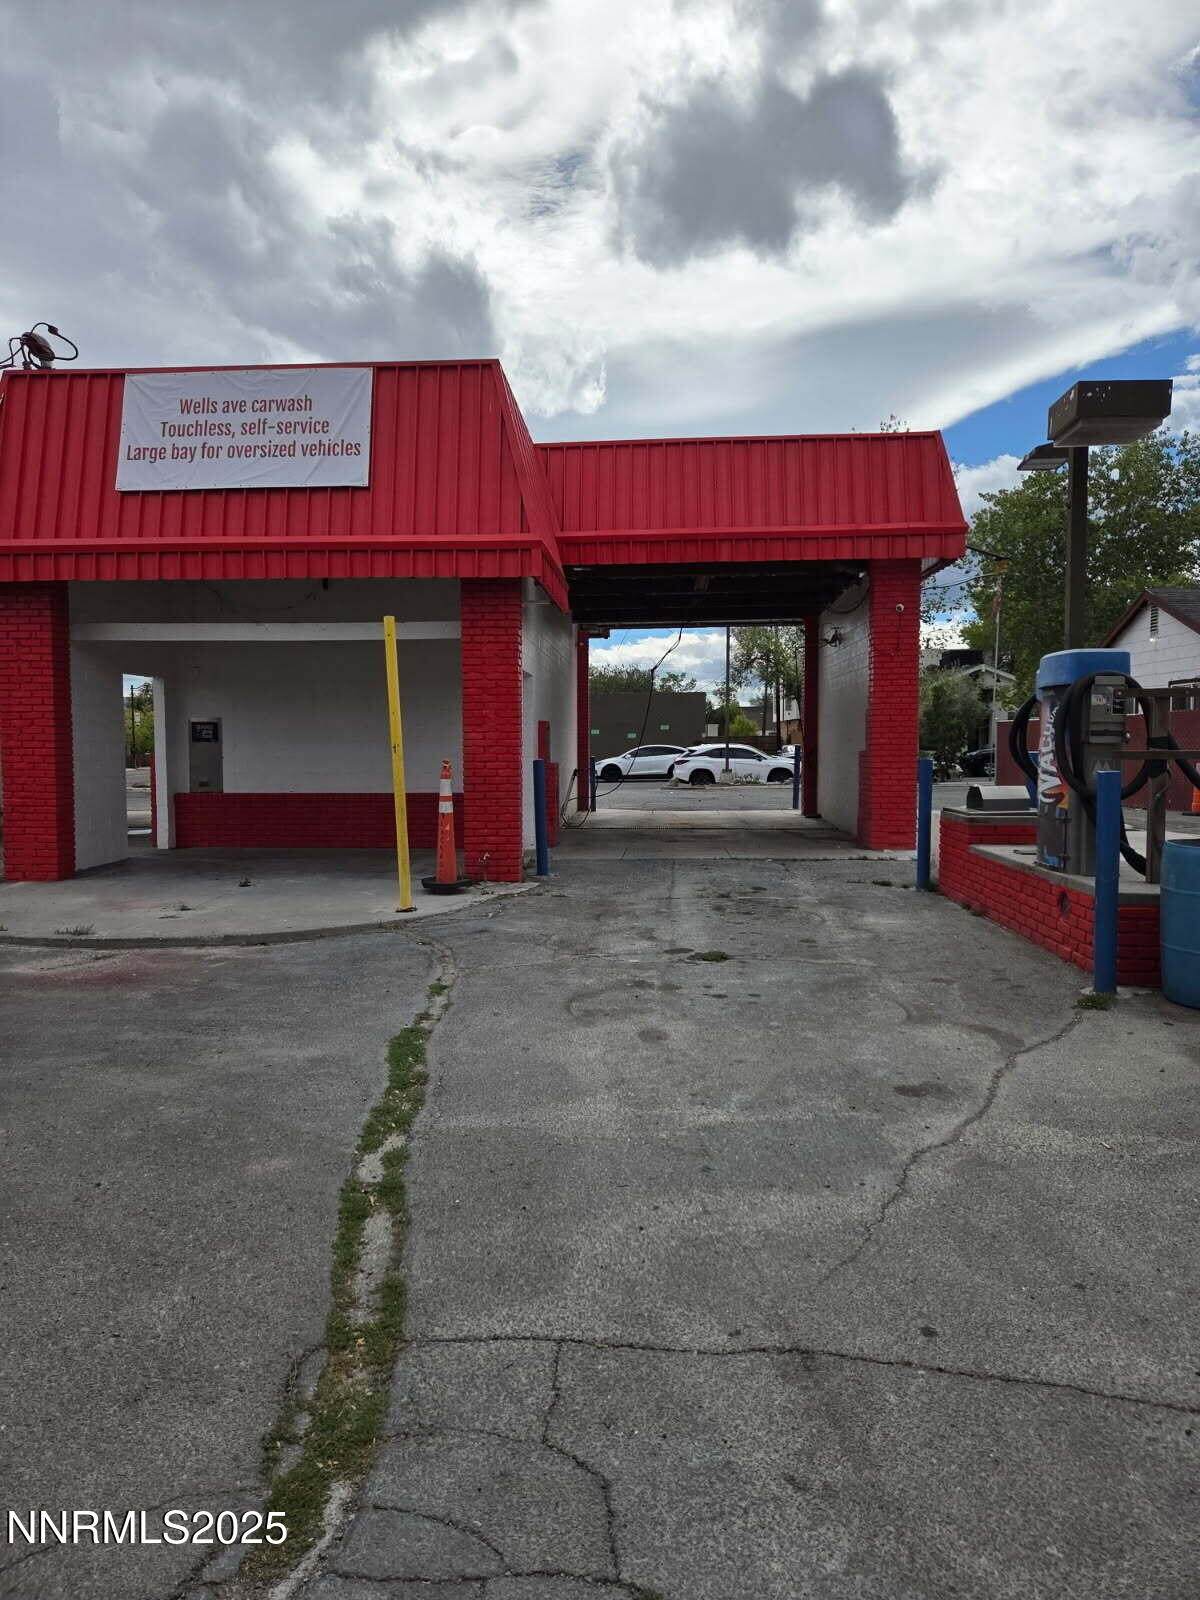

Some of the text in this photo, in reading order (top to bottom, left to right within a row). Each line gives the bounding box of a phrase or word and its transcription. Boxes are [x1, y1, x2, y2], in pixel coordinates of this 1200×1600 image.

[180, 395, 313, 415] Wells ave carwash
[160, 417, 330, 439] Touchless, self-service
[126, 438, 362, 464] Large bay for oversized vehicles
